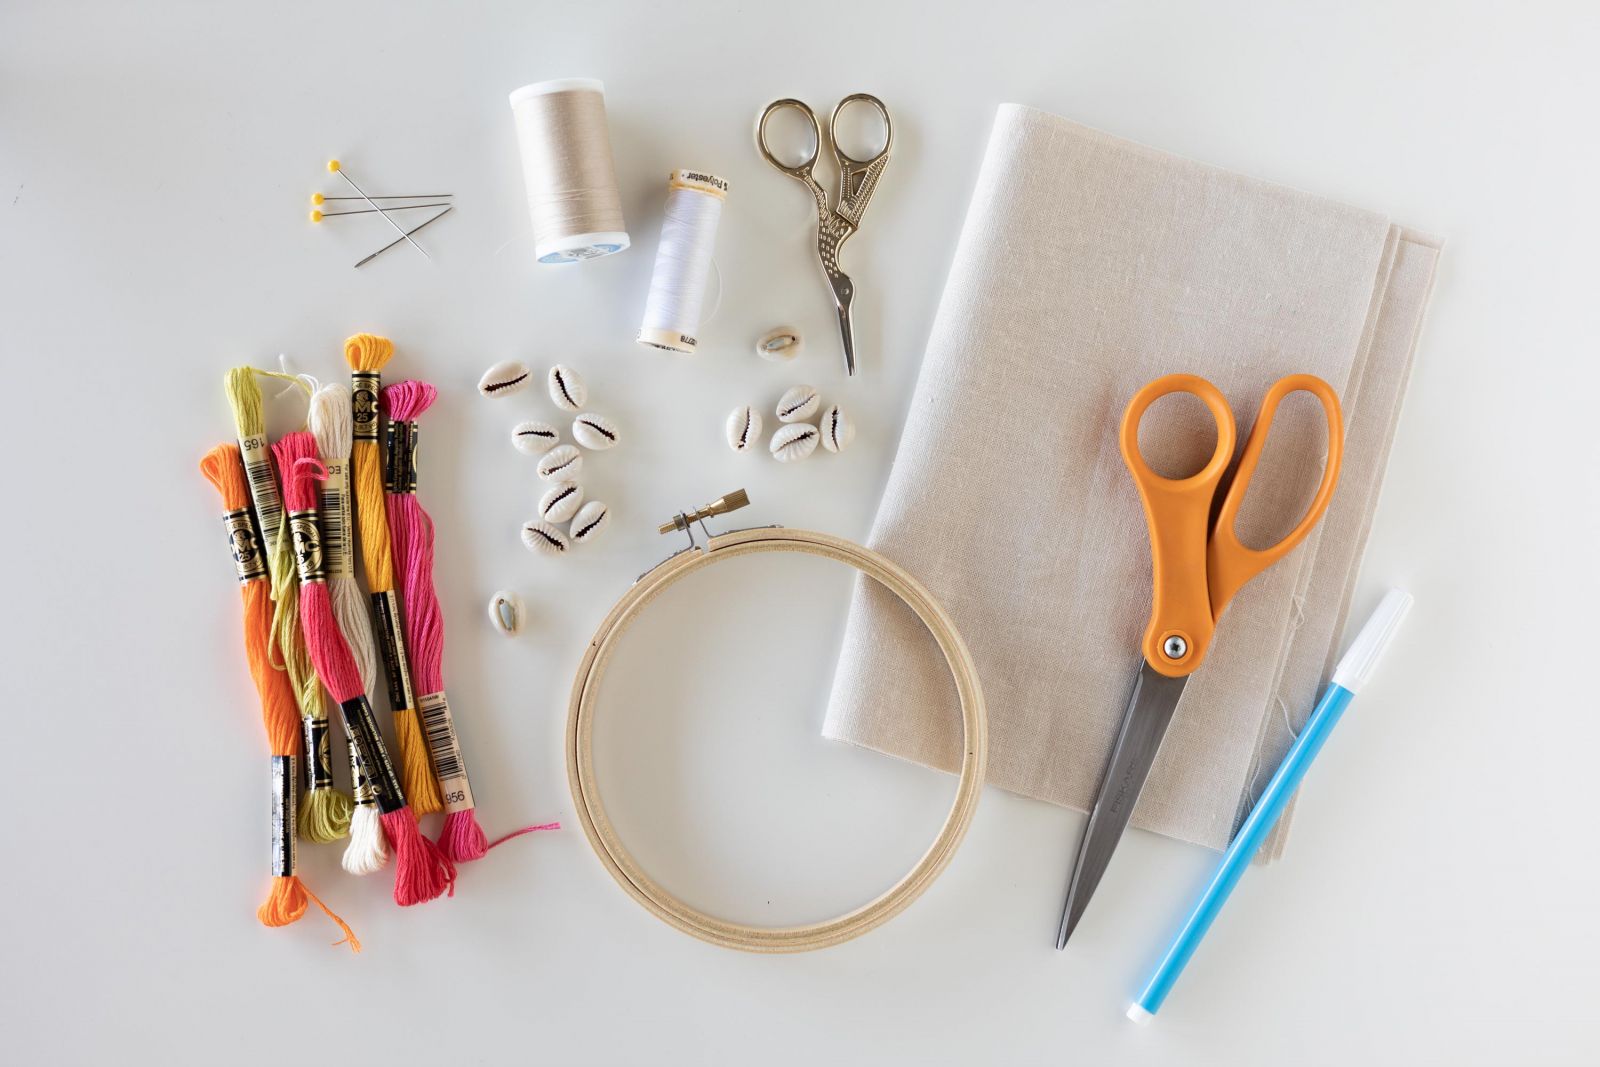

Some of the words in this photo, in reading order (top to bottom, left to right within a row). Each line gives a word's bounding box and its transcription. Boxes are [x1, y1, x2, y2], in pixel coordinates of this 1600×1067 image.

[687, 172, 723, 189] Polyester
[357, 413, 368, 421] 25
[244, 437, 265, 451] 165
[446, 790, 465, 804] 956
